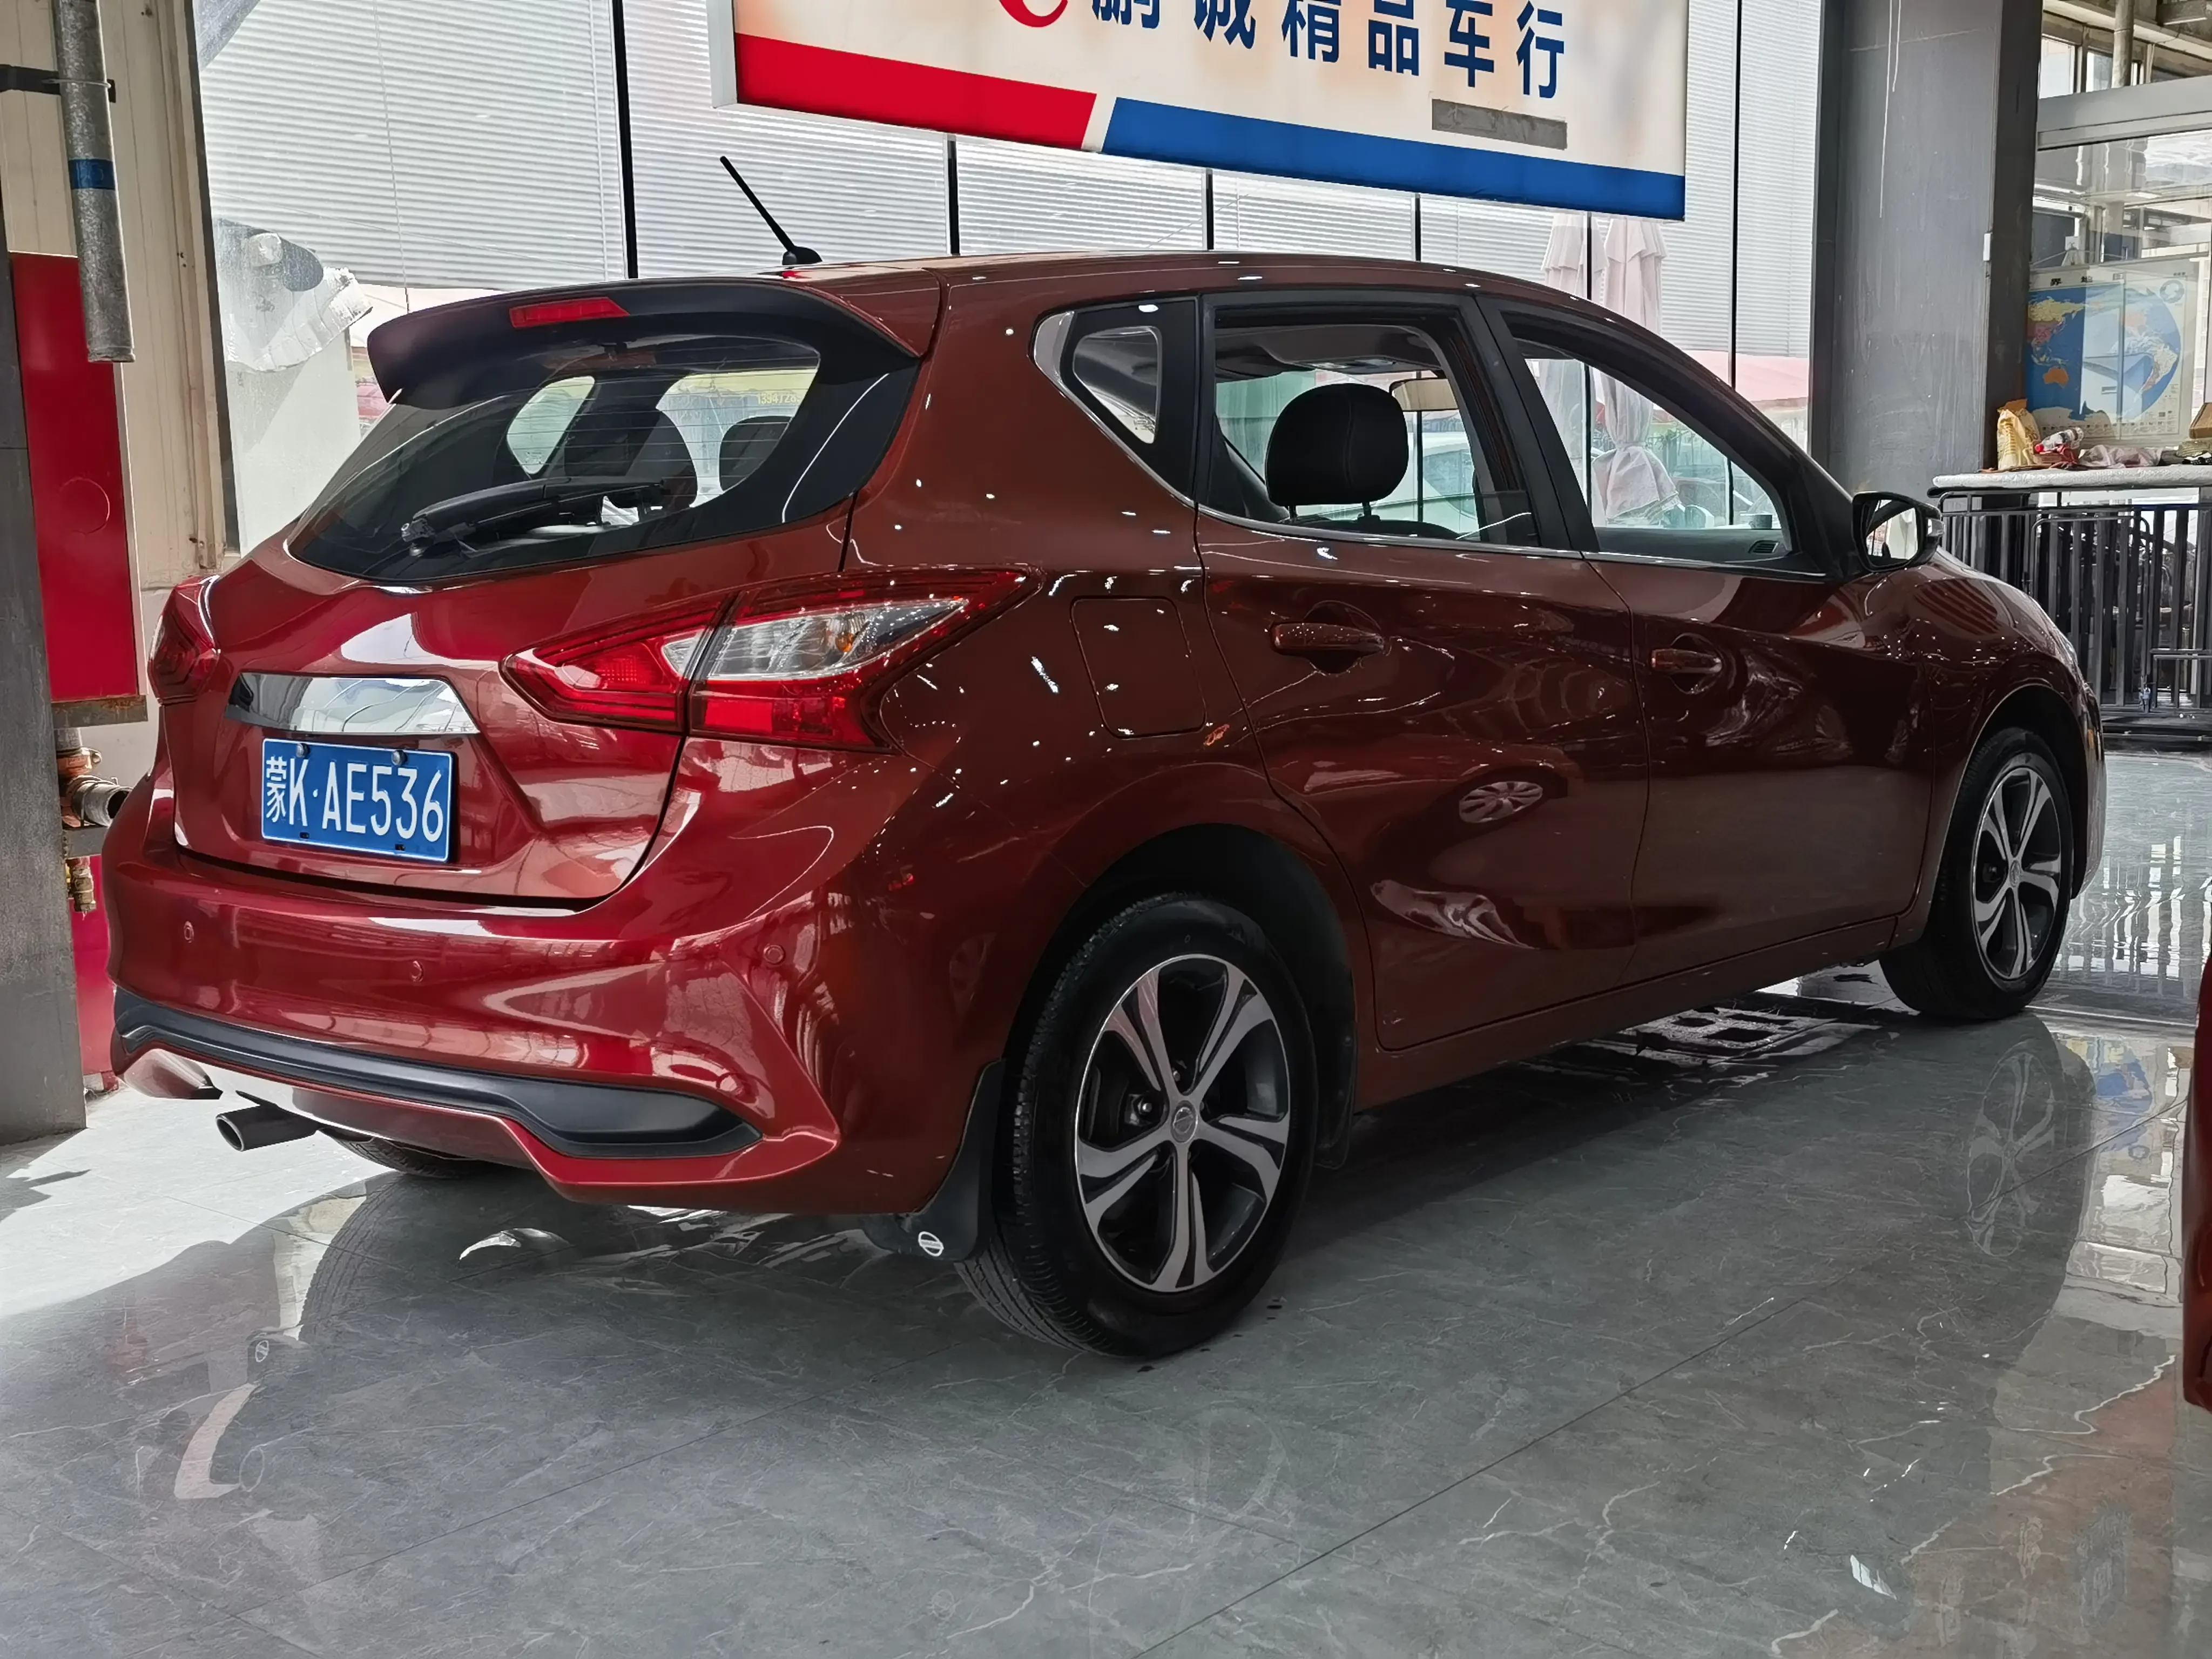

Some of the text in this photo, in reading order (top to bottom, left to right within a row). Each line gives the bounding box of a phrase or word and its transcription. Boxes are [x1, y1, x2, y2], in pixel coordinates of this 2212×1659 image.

[1091, 0, 1565, 99] 精品车行
[2029, 273, 2123, 286] 界地图
